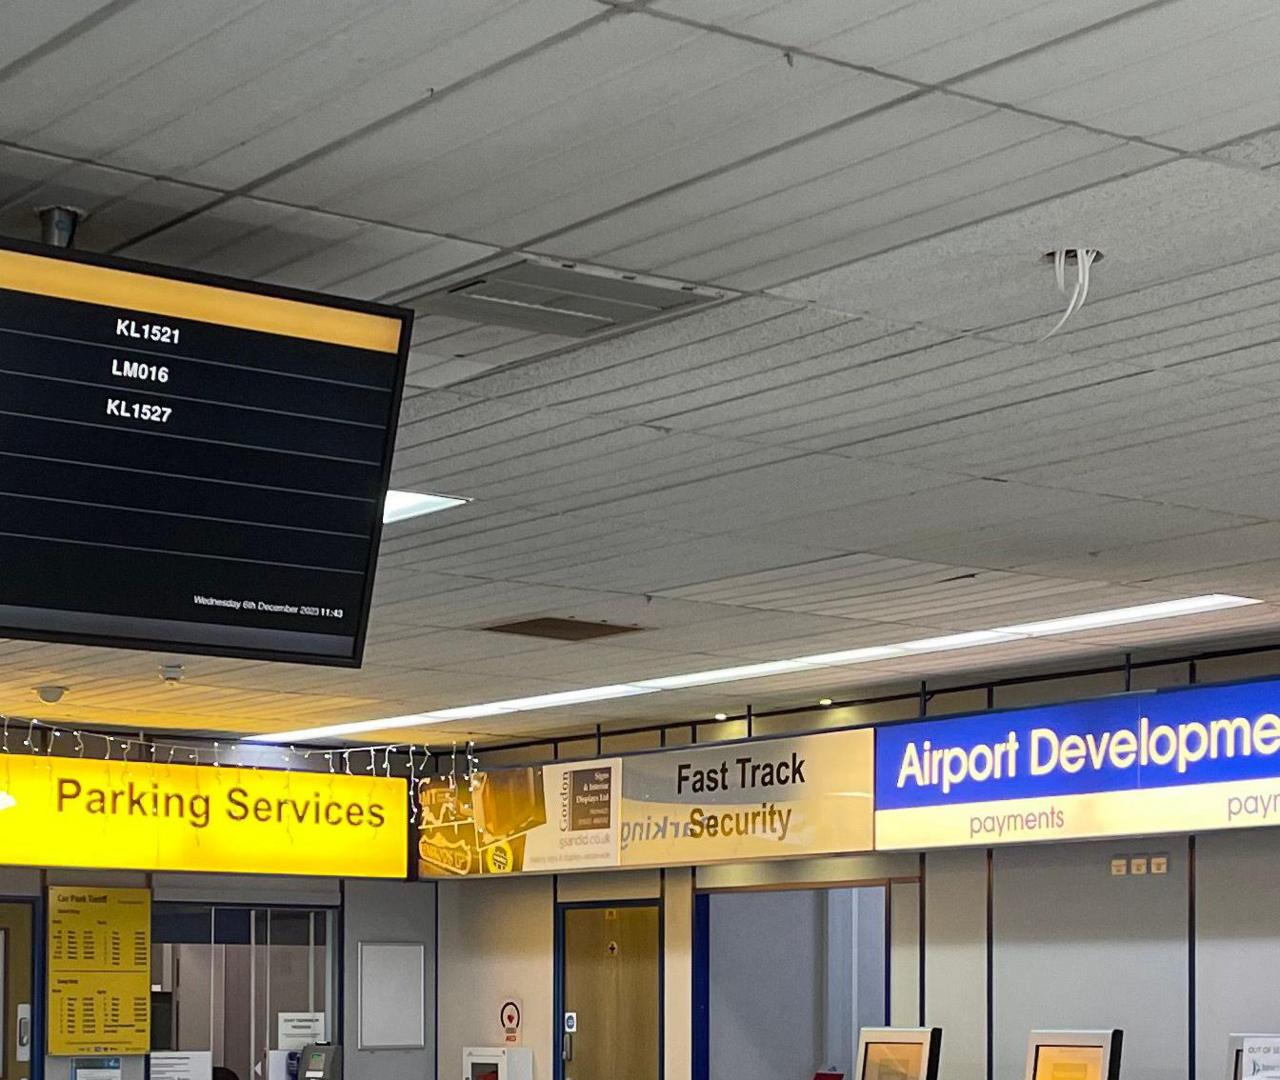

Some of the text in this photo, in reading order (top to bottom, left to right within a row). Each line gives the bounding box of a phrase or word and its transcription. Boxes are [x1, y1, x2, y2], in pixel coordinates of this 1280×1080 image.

[116, 319, 180, 344] KL1521
[111, 359, 169, 383] LM016
[106, 398, 173, 422] KL1527
[194, 595, 241, 609] Wednesday
[258, 601, 298, 614] December
[677, 752, 806, 795] Fast Track
[896, 729, 1020, 794] Airport
[56, 777, 386, 830] Parking Services
[560, 771, 569, 832] Gordon
[690, 803, 792, 841] Security
[969, 805, 1065, 840] payments
